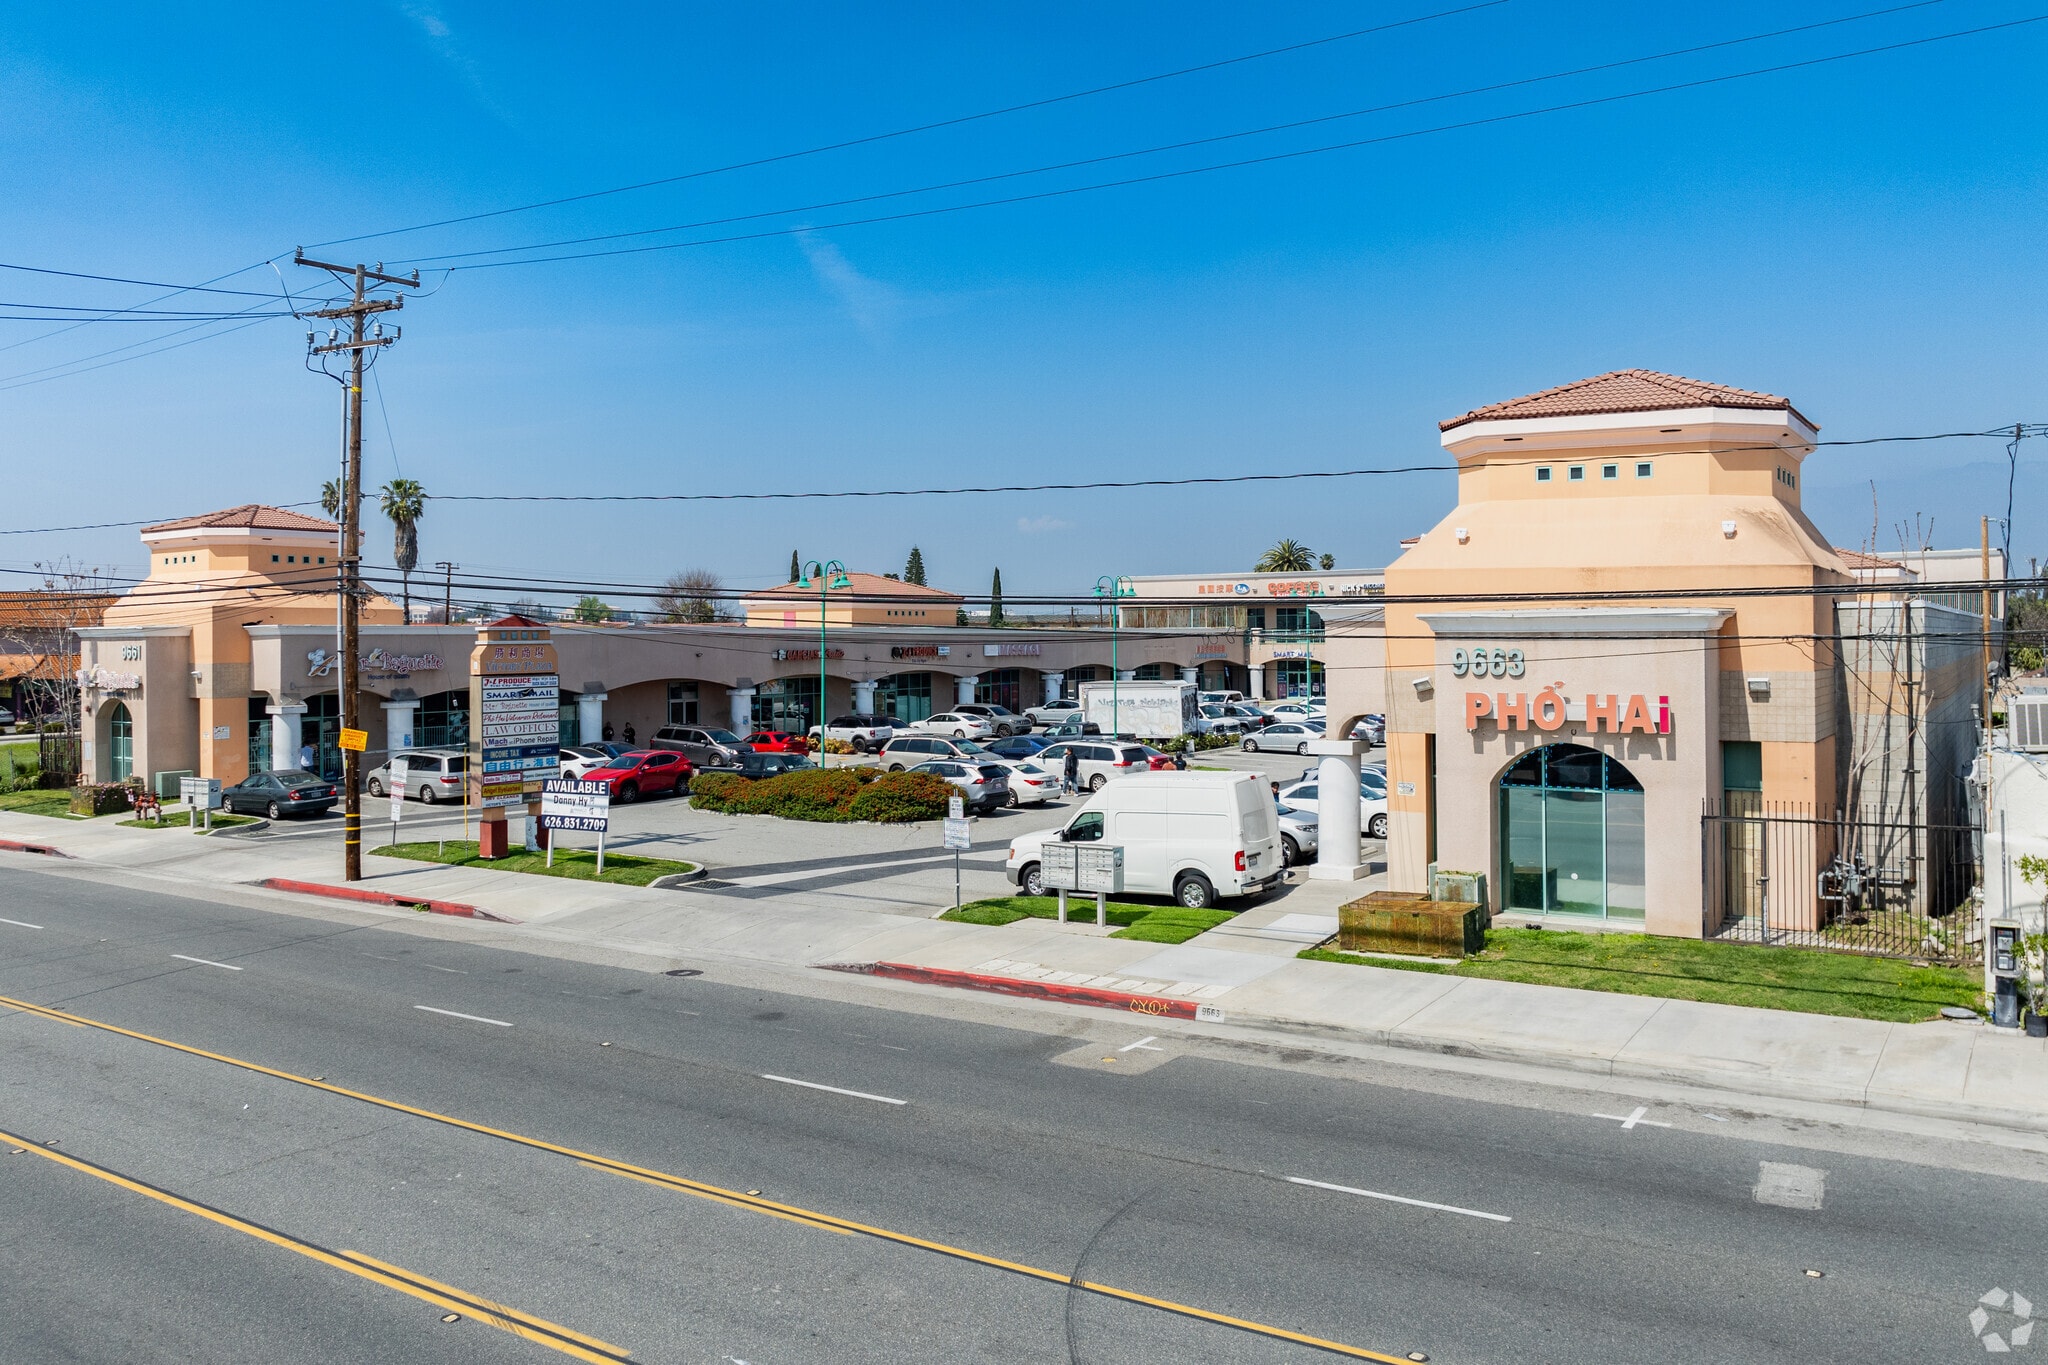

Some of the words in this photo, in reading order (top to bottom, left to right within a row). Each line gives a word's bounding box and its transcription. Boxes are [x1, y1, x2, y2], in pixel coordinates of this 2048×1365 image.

[1267, 581, 1320, 593] COFFEE
[121, 645, 142, 660] 9661
[999, 644, 1040, 656] MASSAGE
[1452, 648, 1526, 678] 9663
[486, 690, 524, 700] SMART
[530, 689, 555, 698] MAIL
[485, 725, 509, 736] LAW
[513, 722, 557, 733] OFFICES
[514, 736, 537, 744] iPhone
[538, 735, 558, 743] Repair
[490, 750, 509, 759] INCOME
[510, 749, 520, 757] TAX
[545, 780, 606, 795] AVAILABLE
[553, 795, 577, 806] Danny
[578, 796, 588, 807] Hy
[544, 816, 606, 831] 626.831.2709
